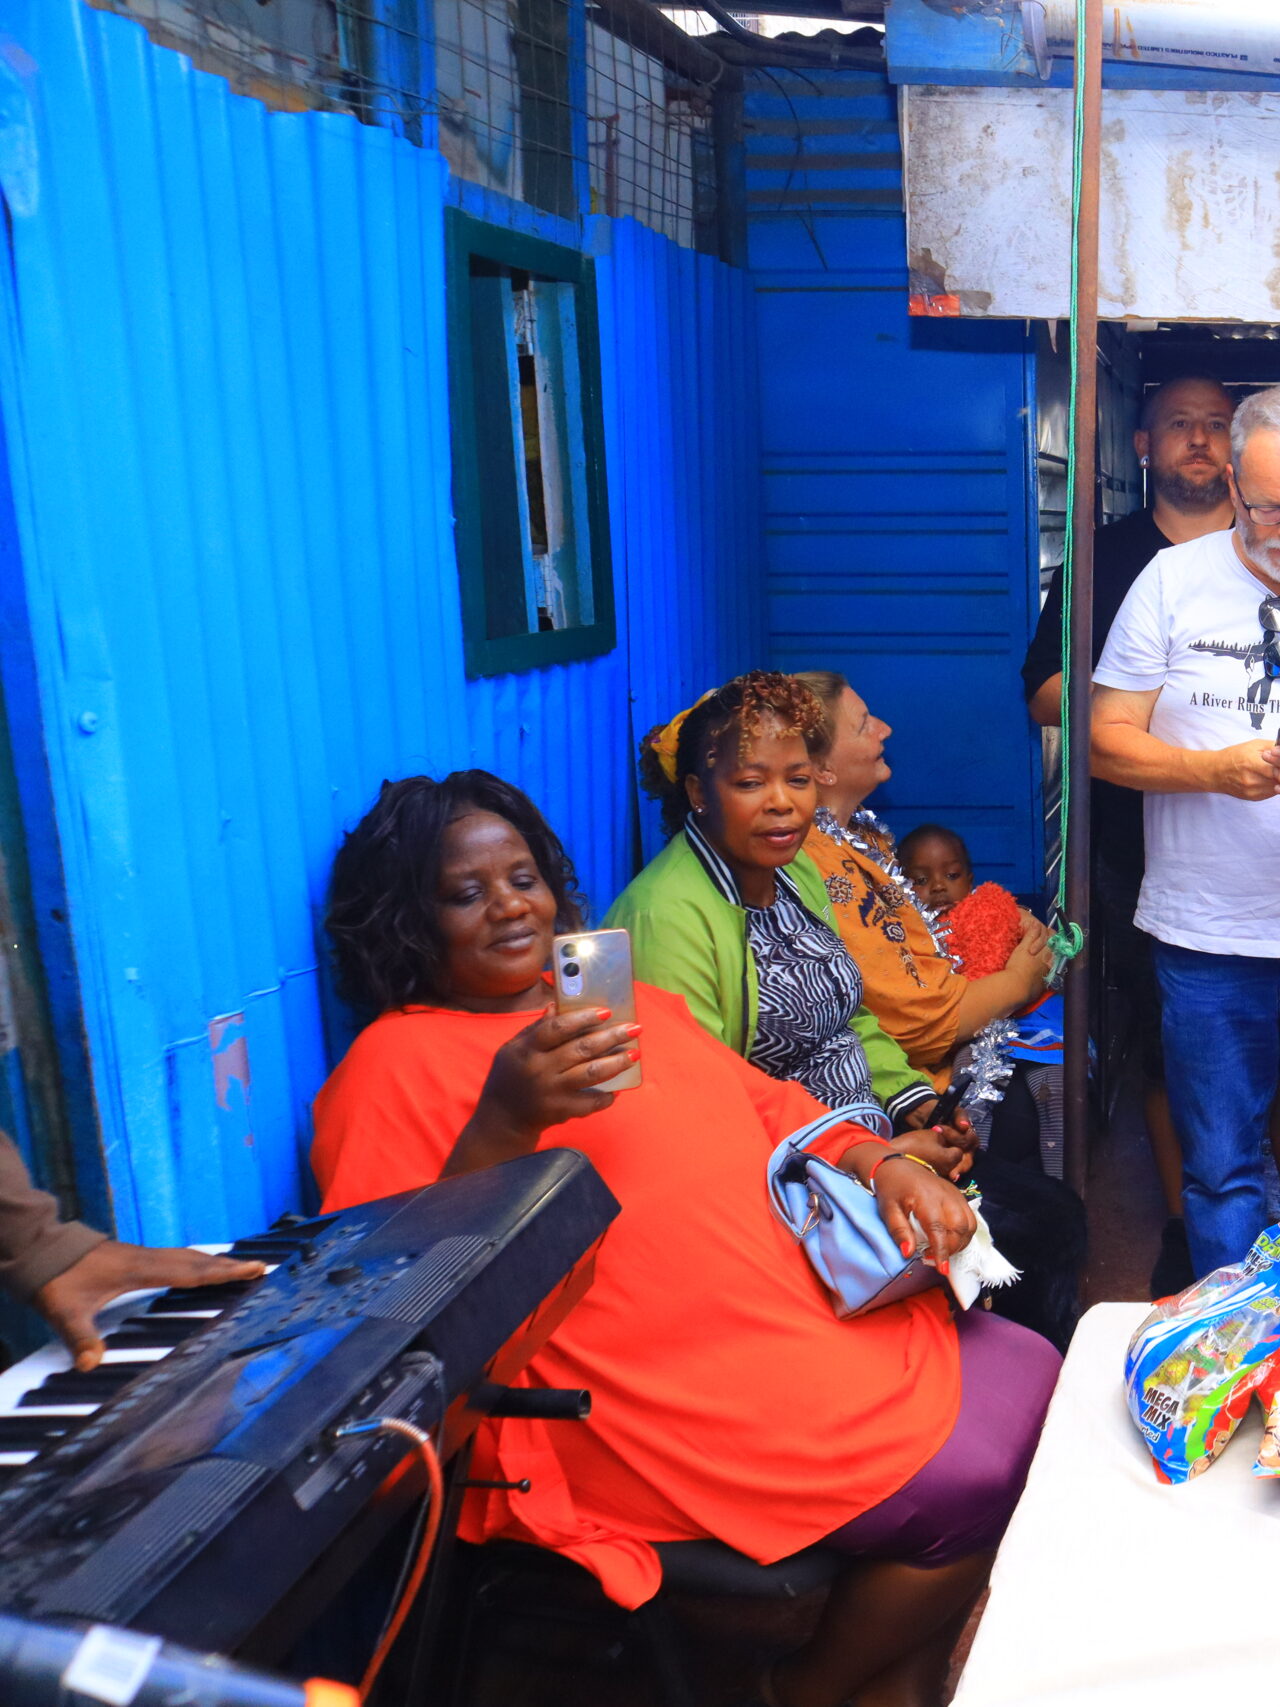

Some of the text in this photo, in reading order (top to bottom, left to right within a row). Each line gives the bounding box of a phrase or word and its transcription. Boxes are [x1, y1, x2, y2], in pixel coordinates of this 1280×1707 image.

[1189, 692, 1198, 706] A
[1202, 692, 1233, 710] River
[1143, 1387, 1180, 1415] MEGA
[1141, 1405, 1172, 1432] MIX
